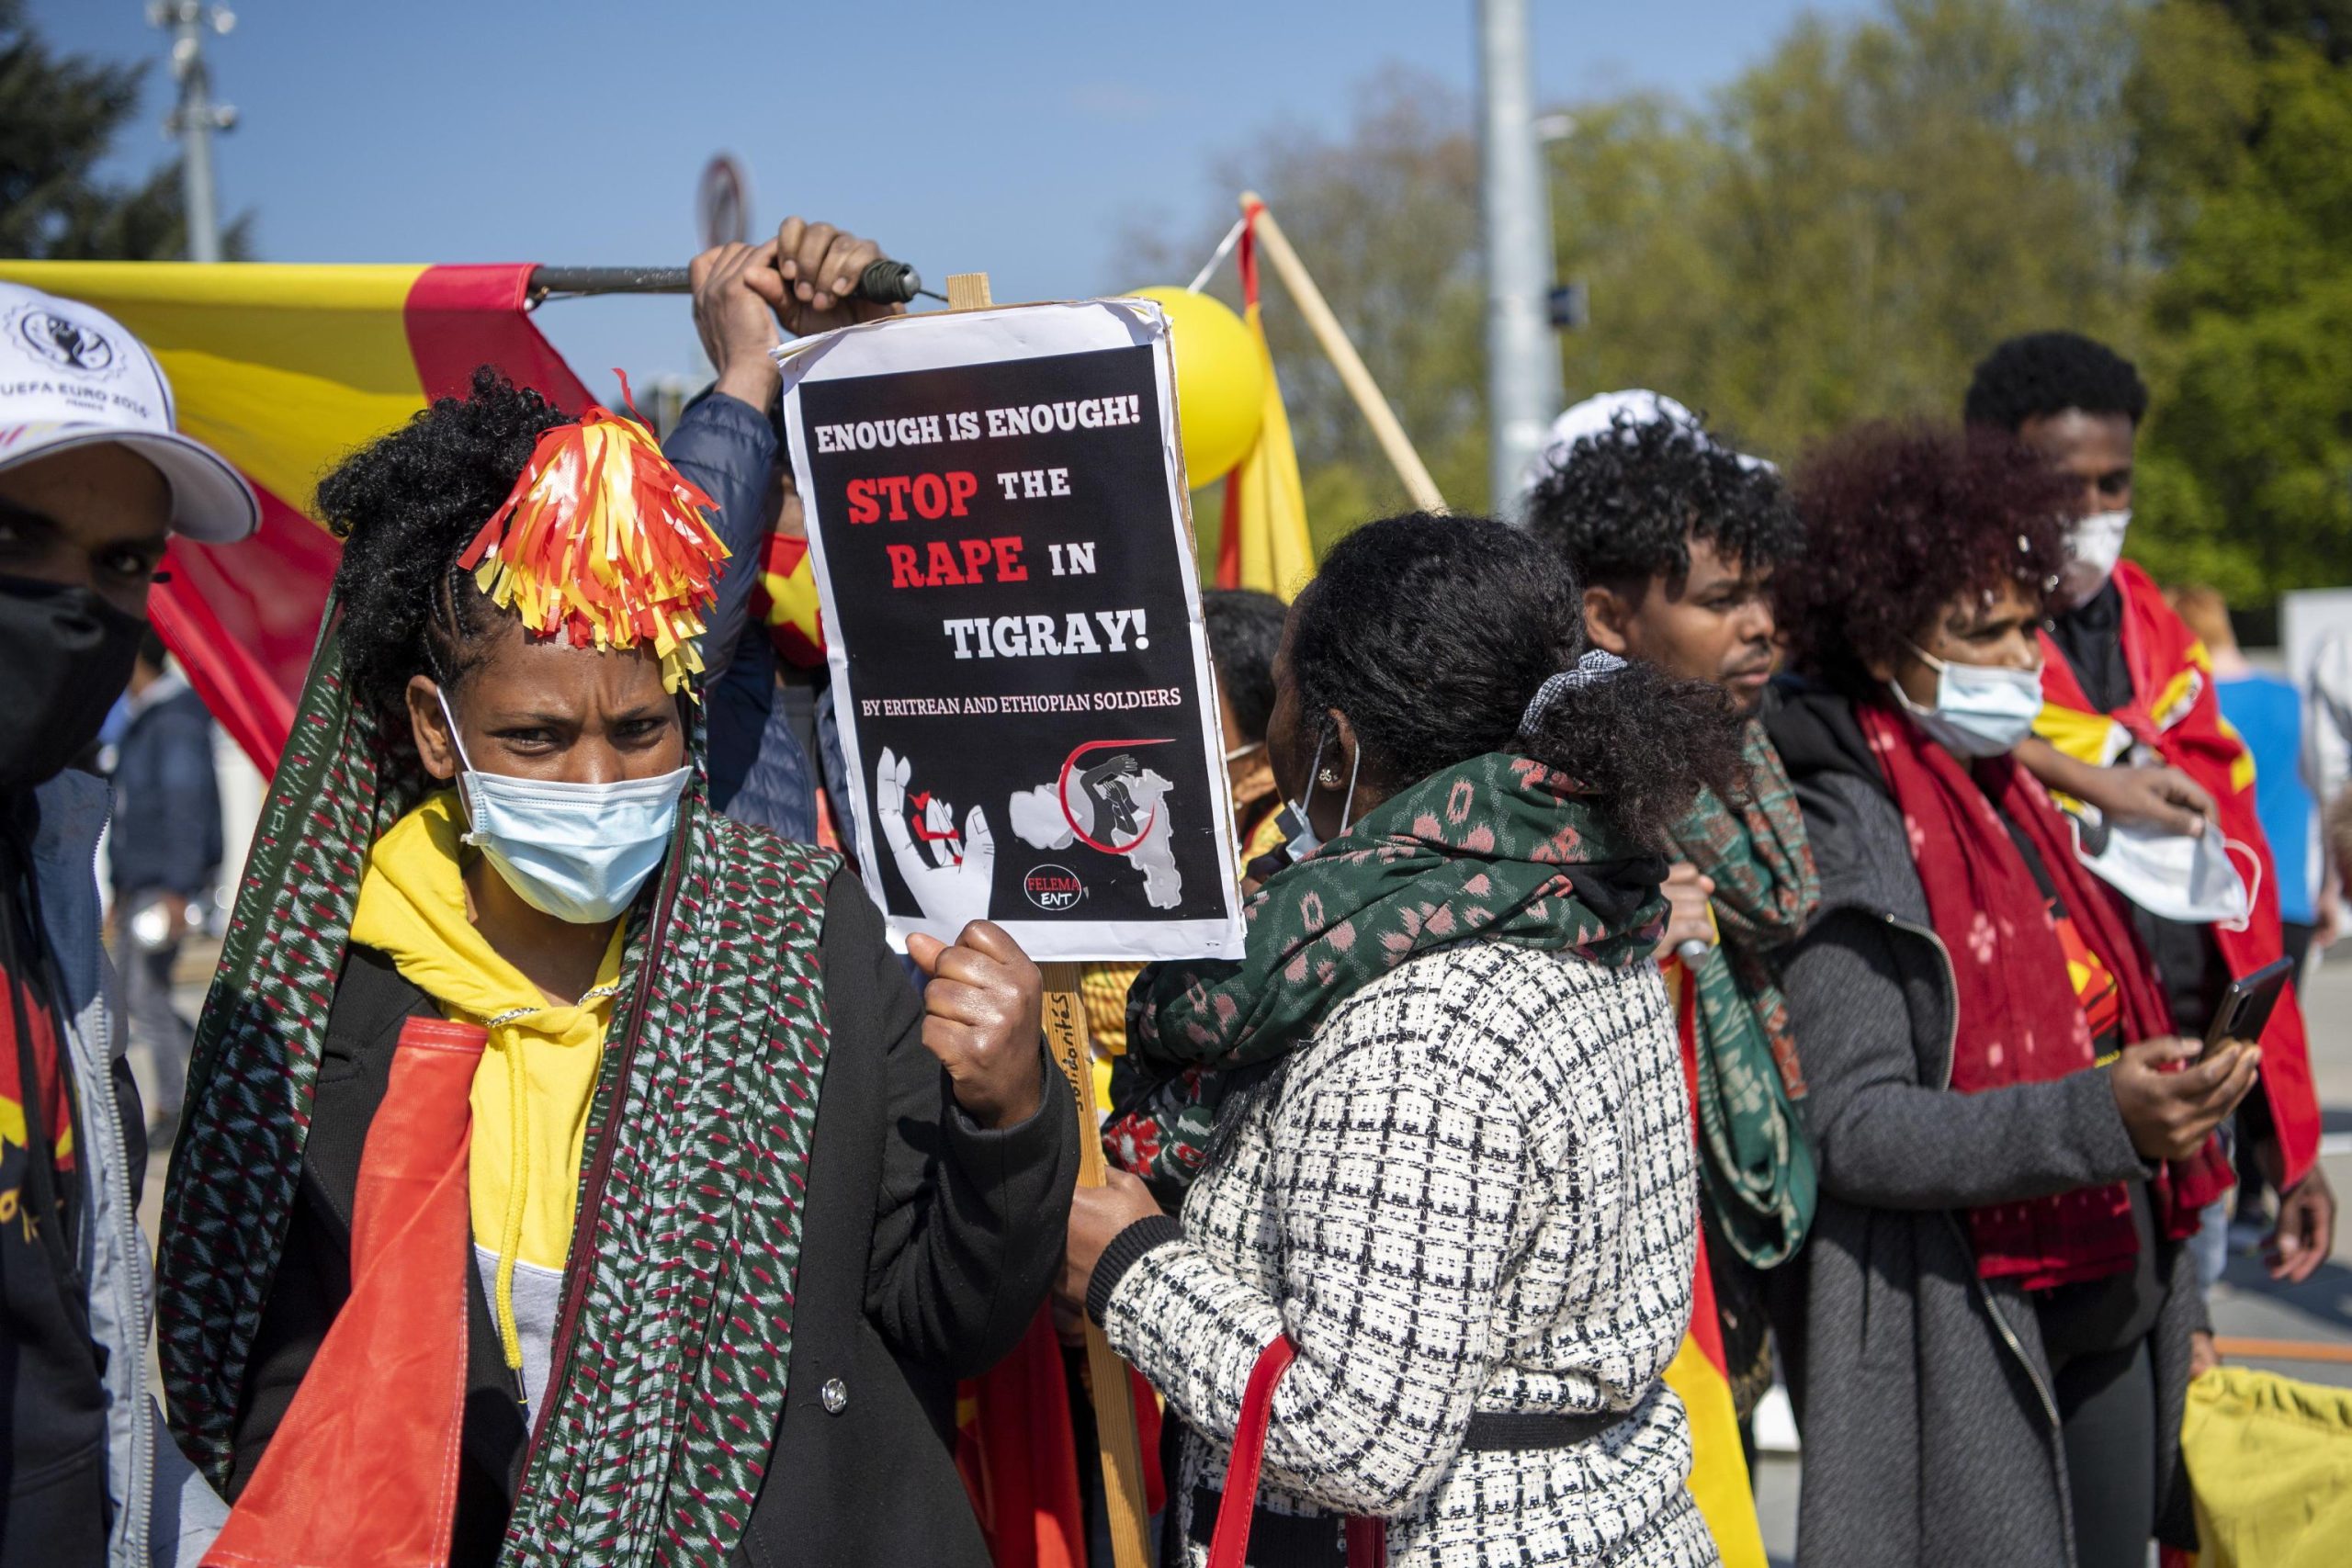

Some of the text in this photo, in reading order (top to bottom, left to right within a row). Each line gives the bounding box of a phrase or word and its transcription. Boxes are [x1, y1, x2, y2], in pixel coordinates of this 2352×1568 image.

[0, 380, 147, 418] UEFA EURO 2016
[815, 393, 1141, 453] ENOUGH IS ENOUGH!
[847, 467, 1070, 525] STOP THE
[887, 536, 1096, 590] RAPE IN
[944, 608, 1149, 660] TIGRAY!
[862, 687, 1182, 716] BY ERITREAN AND ETHIOPIAN SOLDIERS
[1027, 877, 1080, 891] FELEMA
[1040, 891, 1072, 907] ENT
